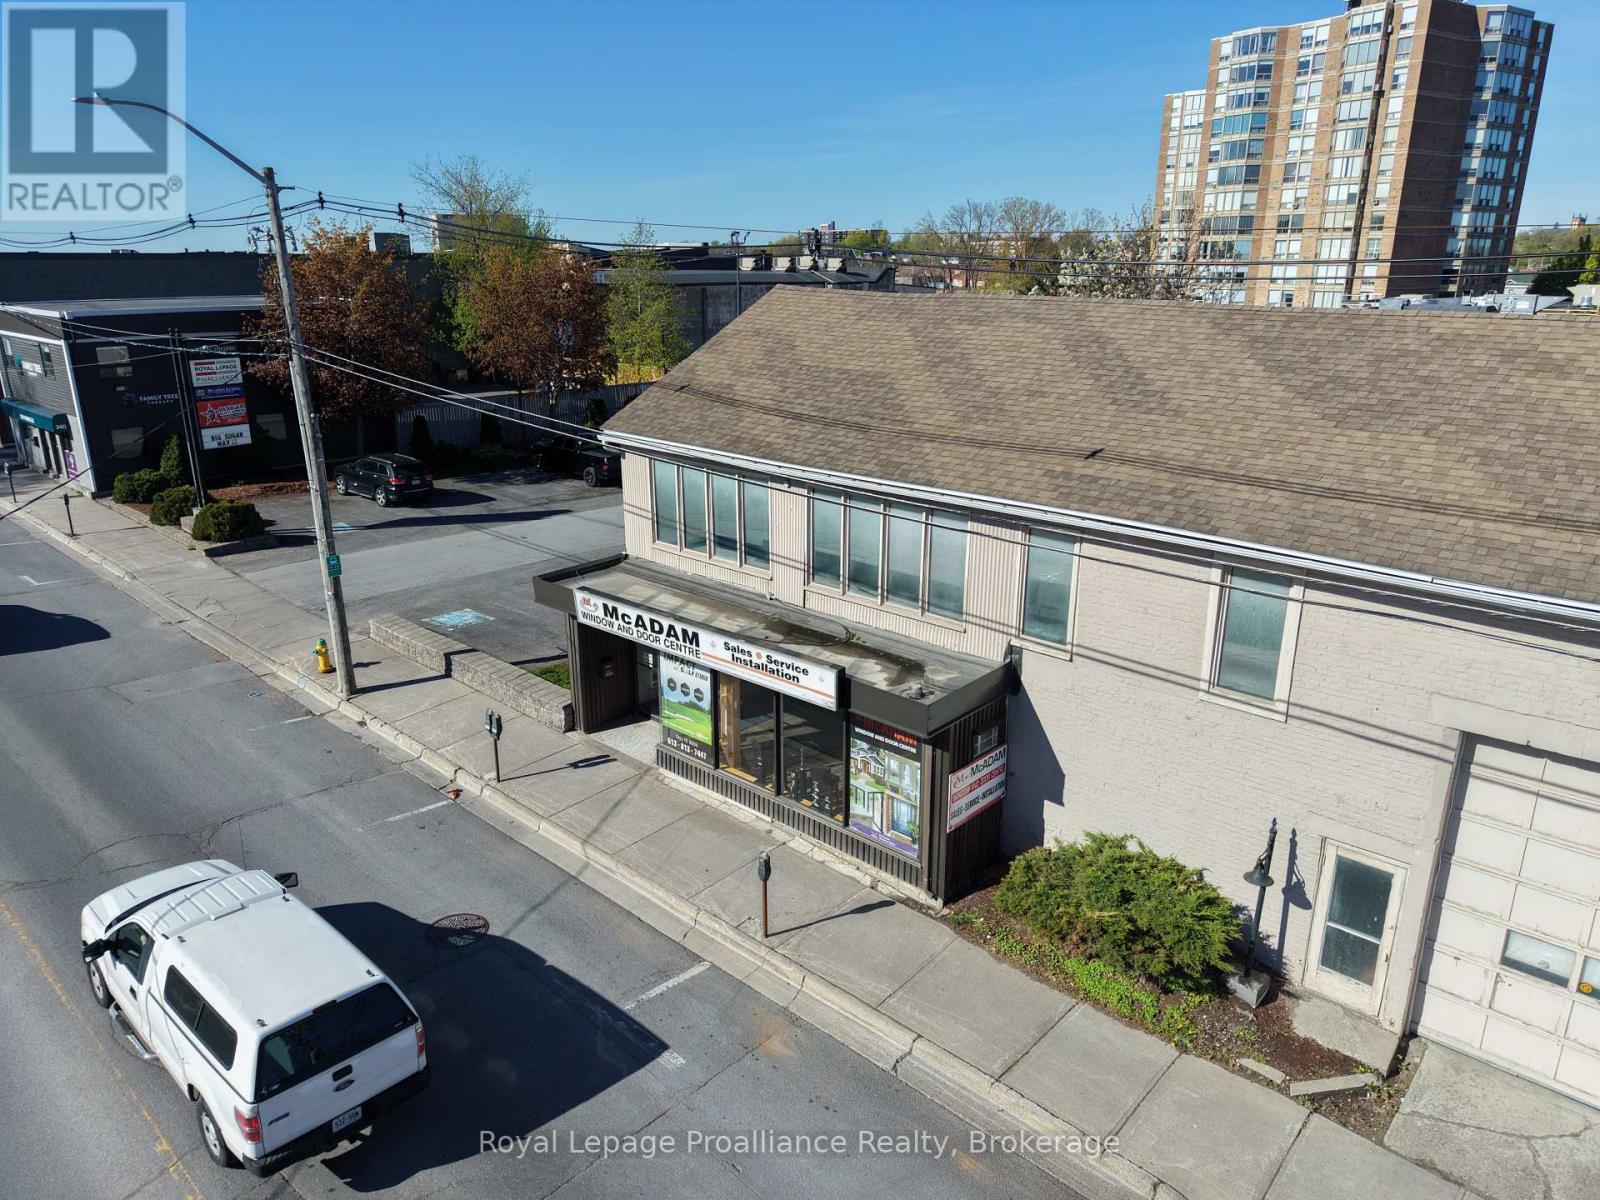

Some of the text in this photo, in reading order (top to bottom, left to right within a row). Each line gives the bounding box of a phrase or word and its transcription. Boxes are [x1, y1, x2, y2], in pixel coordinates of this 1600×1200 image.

[581, 610, 701, 659] WINDOW AND DOOR CENTRE
[723, 641, 809, 676] Sales Service
[731, 653, 800, 684] Installation
